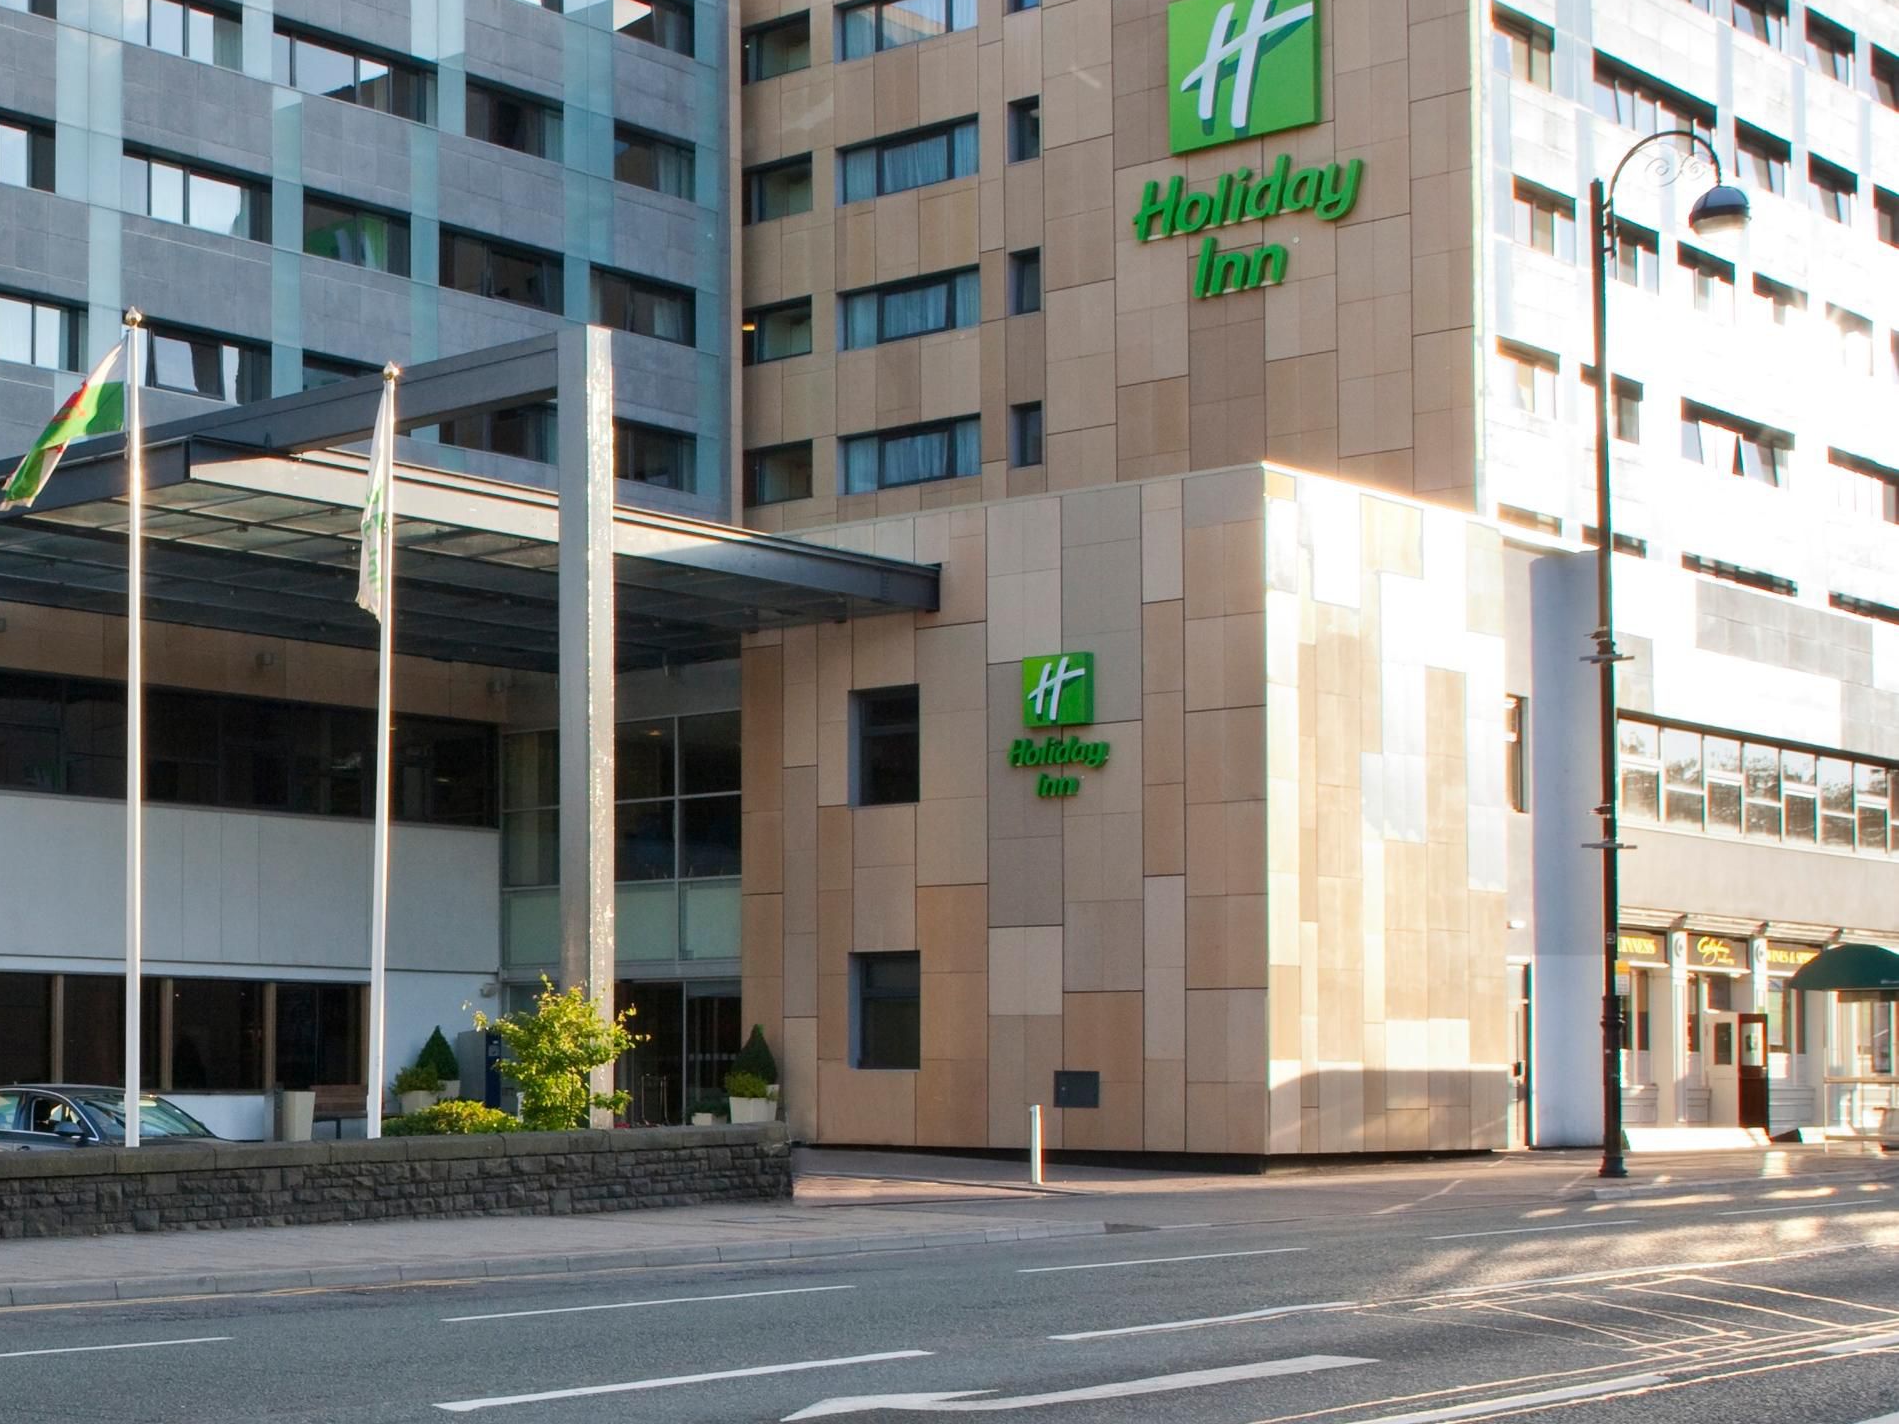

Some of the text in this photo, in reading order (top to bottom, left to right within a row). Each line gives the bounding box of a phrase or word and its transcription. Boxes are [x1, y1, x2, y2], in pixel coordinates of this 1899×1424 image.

[1133, 153, 1364, 242] Holiday
[1193, 236, 1289, 299] Inn
[1009, 736, 1110, 768] Holiday
[1037, 773, 1081, 798] Inn
